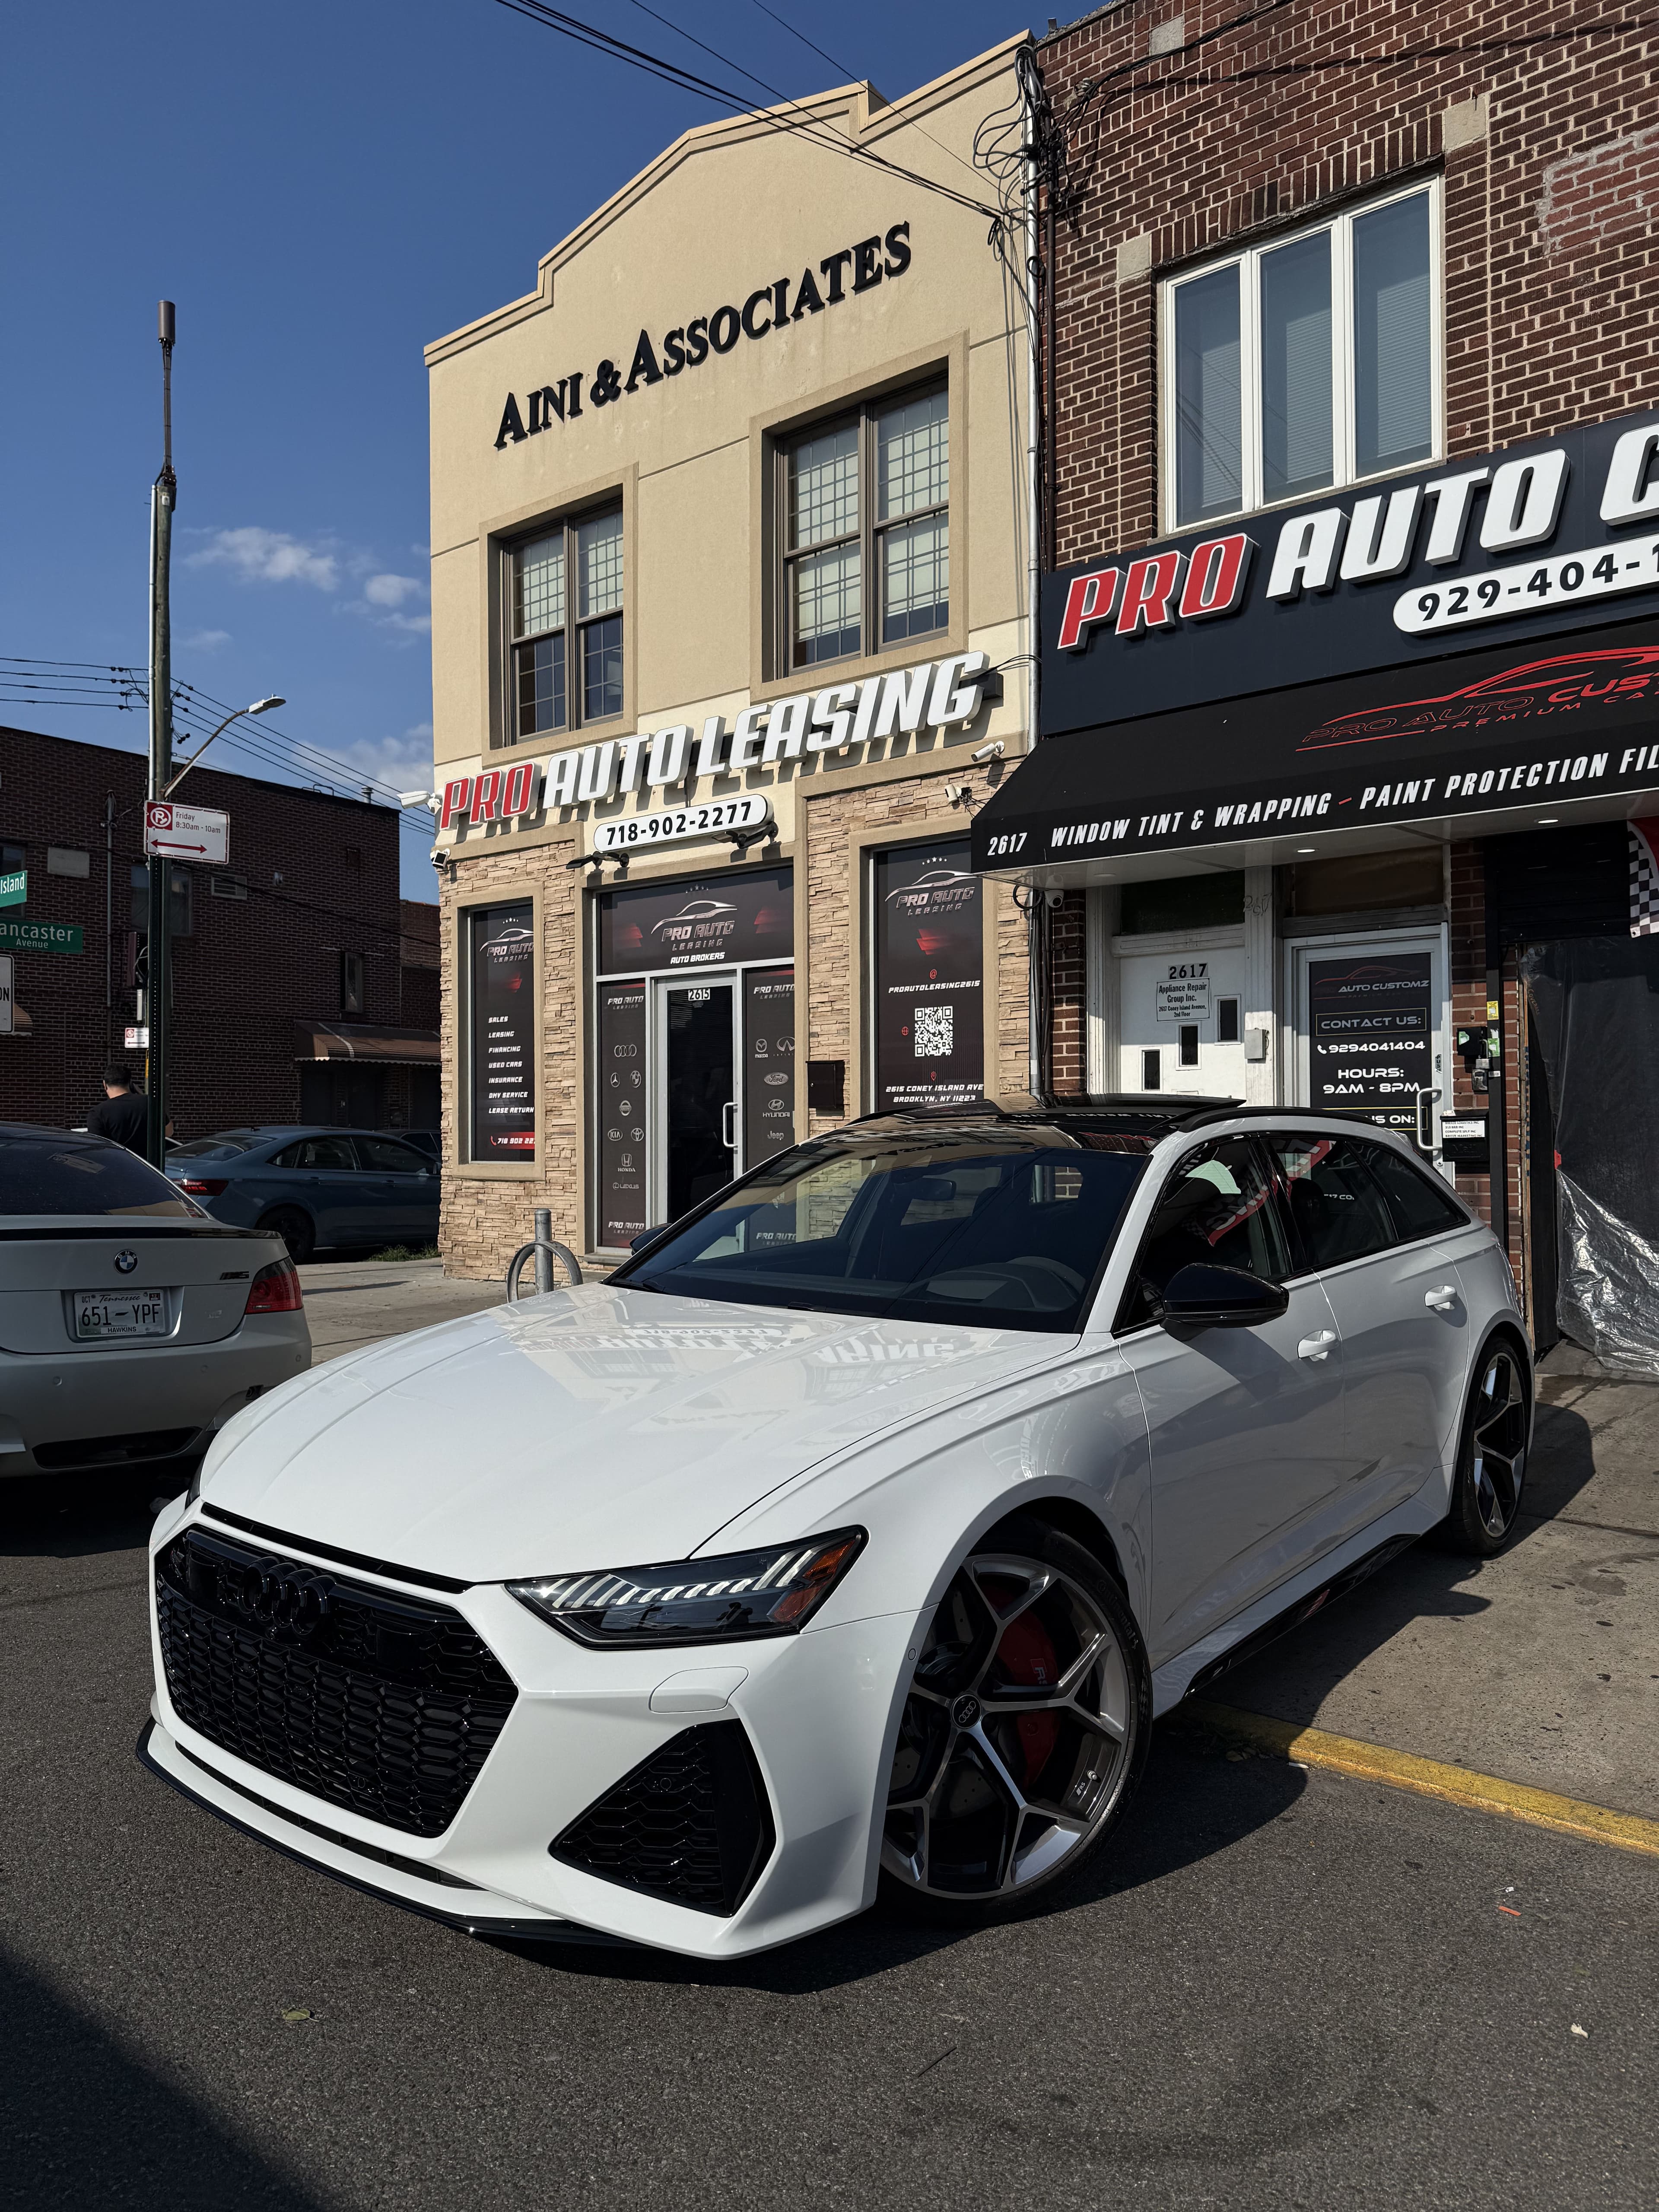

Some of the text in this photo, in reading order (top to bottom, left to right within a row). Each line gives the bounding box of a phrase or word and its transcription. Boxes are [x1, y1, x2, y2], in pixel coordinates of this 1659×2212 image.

[493, 221, 911, 451] AINI & ASSOCIATES
[1057, 533, 1250, 652] PRO
[1266, 448, 1570, 601] AUTO
[1302, 671, 1659, 742] PRO AUTO CUS
[1430, 690, 1659, 732] PREMIUM CA
[440, 650, 989, 831] PRO AUTO LEASING
[987, 833, 1027, 856] 2617
[1051, 819, 1130, 847] WINDOW
[1138, 811, 1184, 836] TINT
[1191, 810, 1204, 830] &
[1214, 792, 1332, 827] WRAPPING
[1359, 779, 1437, 810] PAINT
[1444, 752, 1609, 799] PROTECTION
[176, 812, 195, 822] Friday
[607, 801, 751, 845] 718-902-2277
[176, 822, 199, 830] 8:30am
[205, 825, 221, 833] 10am
[0, 872, 25, 894] Island
[896, 887, 975, 908] PRO AUTO
[908, 903, 963, 915] LEASING
[661, 920, 735, 942] PRO AUTO
[16, 938, 48, 948] Avenue
[672, 938, 724, 951] LEASING
[487, 942, 534, 957] PRO AUTO
[494, 954, 528, 963] LEASING
[671, 952, 725, 964] AUTO BROKERS
[1169, 963, 1207, 980] 2617
[754, 985, 772, 994] PRO
[888, 980, 981, 994] PROAUTOLEASING2615
[1159, 982, 1207, 995] Appliance Repair
[1338, 980, 1430, 992] AUTO CUSTOMZ
[623, 995, 644, 1004] AUTO
[689, 988, 709, 1000] 2615
[1167, 995, 1184, 1004] Group
[1321, 1016, 1421, 1029] CONTACT US:
[1328, 1041, 1426, 1053] 9294041404
[769, 1074, 784, 1083] Ford
[1338, 1067, 1405, 1079] HOURS:
[1323, 1084, 1364, 1094] 9AM
[1379, 1082, 1420, 1093] 8PM
[1389, 1115, 1415, 1123] ON:
[767, 1130, 784, 1141] Jeep
[99, 1294, 140, 1303] Tennessee
[82, 1303, 160, 1326] 651 YPF
[1079, 1782, 1085, 1790] RS
